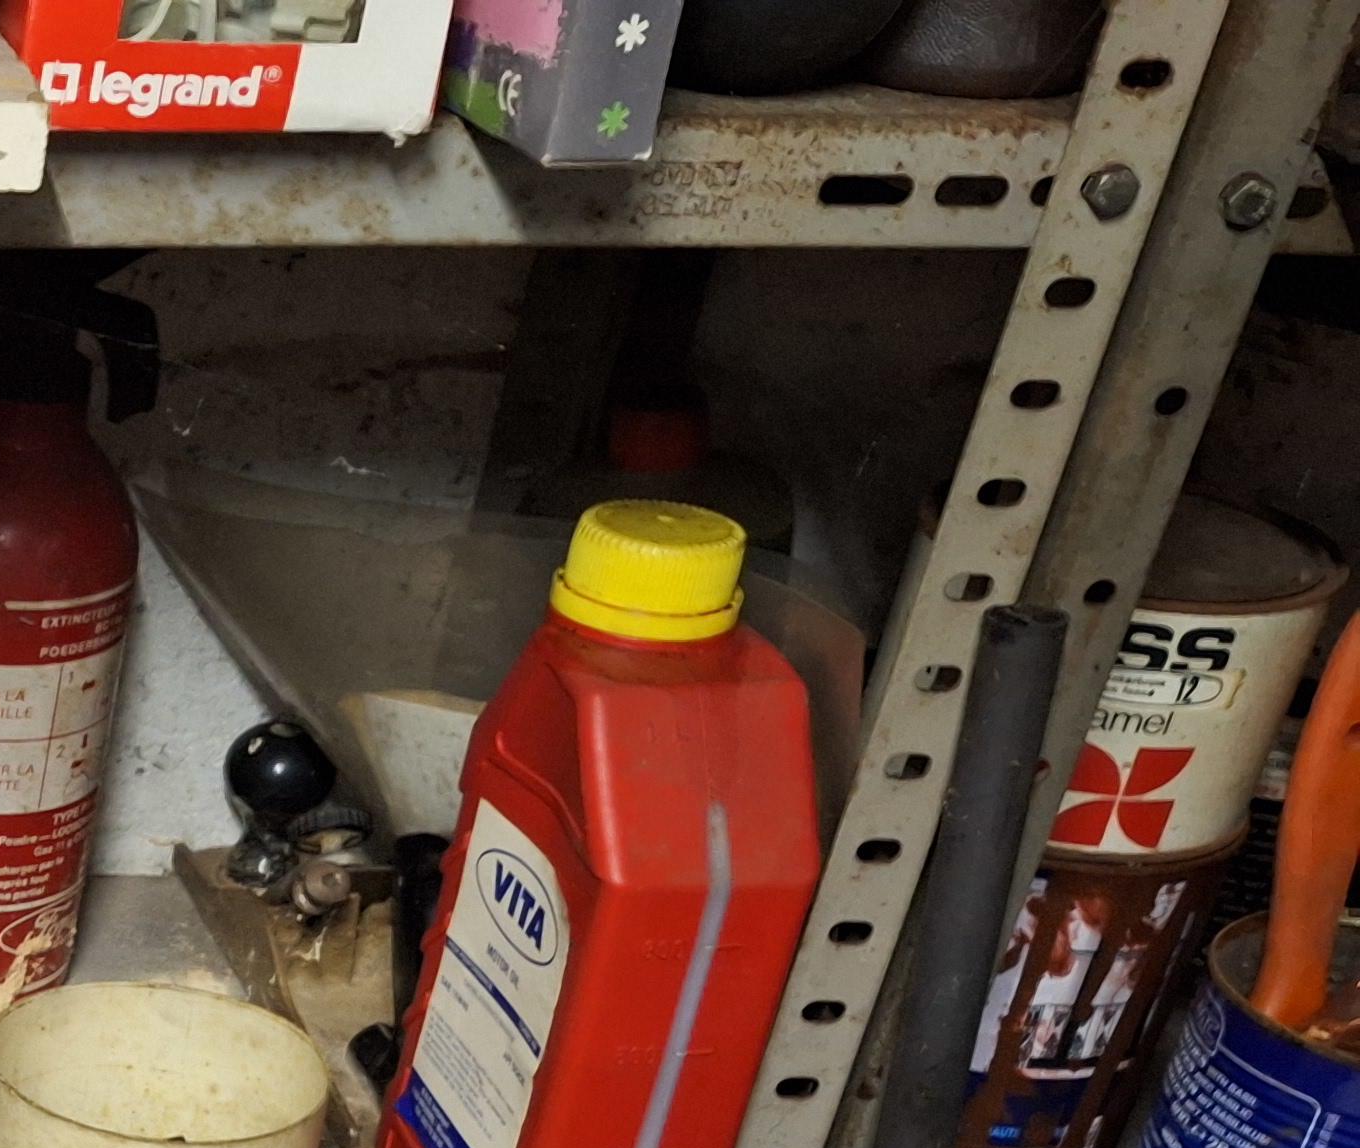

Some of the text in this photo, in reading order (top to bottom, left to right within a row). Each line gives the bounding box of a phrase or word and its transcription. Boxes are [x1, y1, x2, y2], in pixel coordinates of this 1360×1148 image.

[89, 61, 263, 117] legrand
[4, 688, 26, 702] LA
[17, 764, 35, 776] LA
[492, 859, 547, 952] VITA
